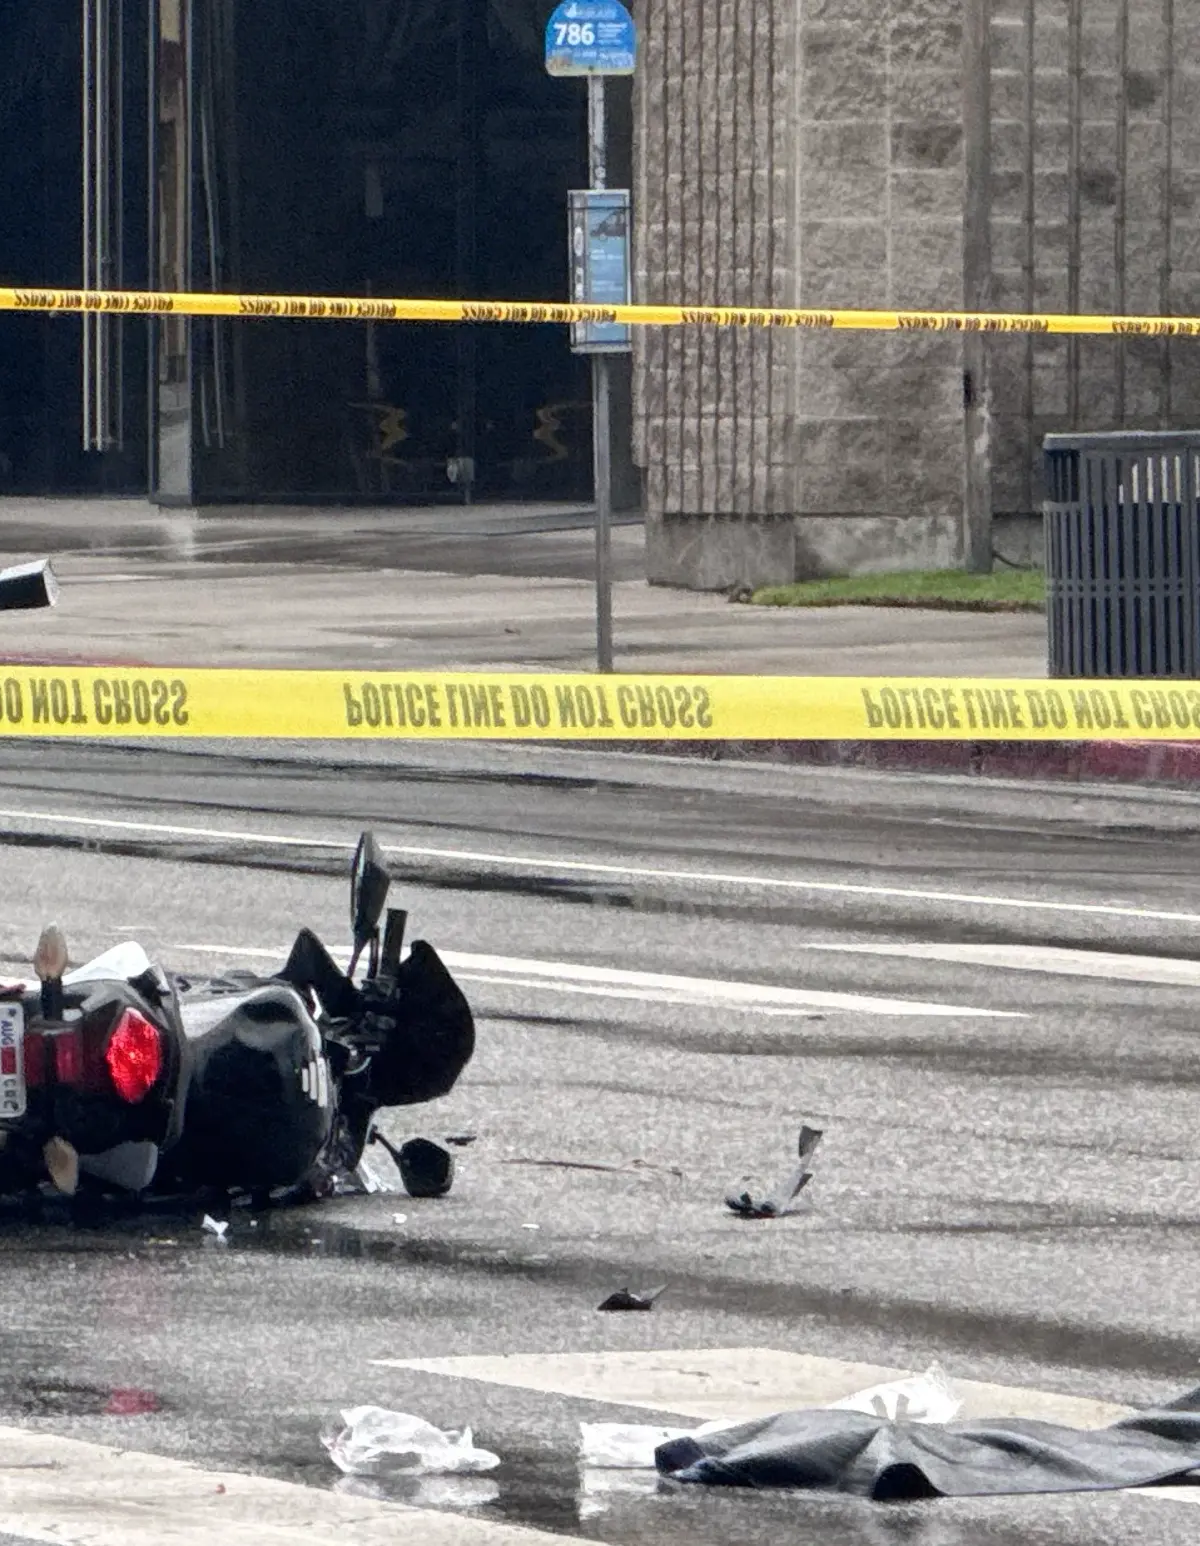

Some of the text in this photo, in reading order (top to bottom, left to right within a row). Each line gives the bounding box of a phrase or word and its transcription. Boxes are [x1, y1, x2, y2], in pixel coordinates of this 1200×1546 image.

[553, 22, 596, 46] 786
[15, 291, 174, 311] POLICE LINE DO NOT CROSS
